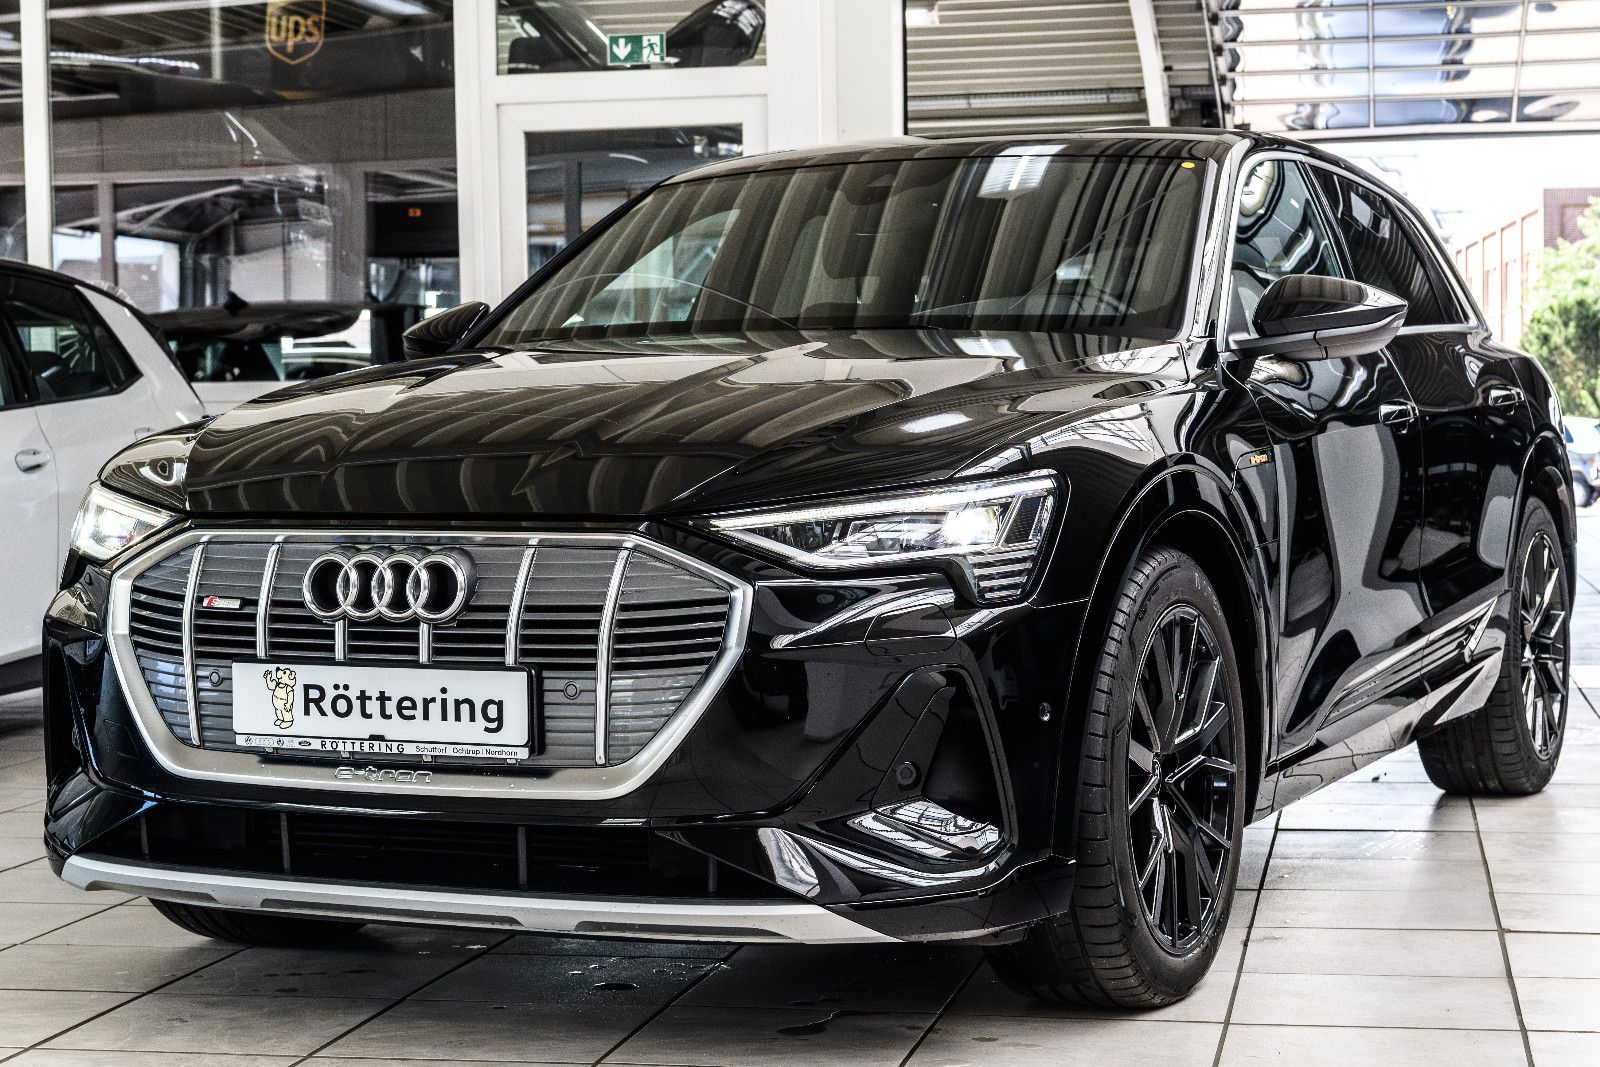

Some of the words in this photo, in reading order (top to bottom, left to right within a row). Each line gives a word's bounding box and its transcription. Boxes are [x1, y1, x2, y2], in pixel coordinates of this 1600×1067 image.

[270, 15, 321, 53] ups
[303, 683, 505, 734] Röttering
[320, 739, 405, 753] RÖTTERING
